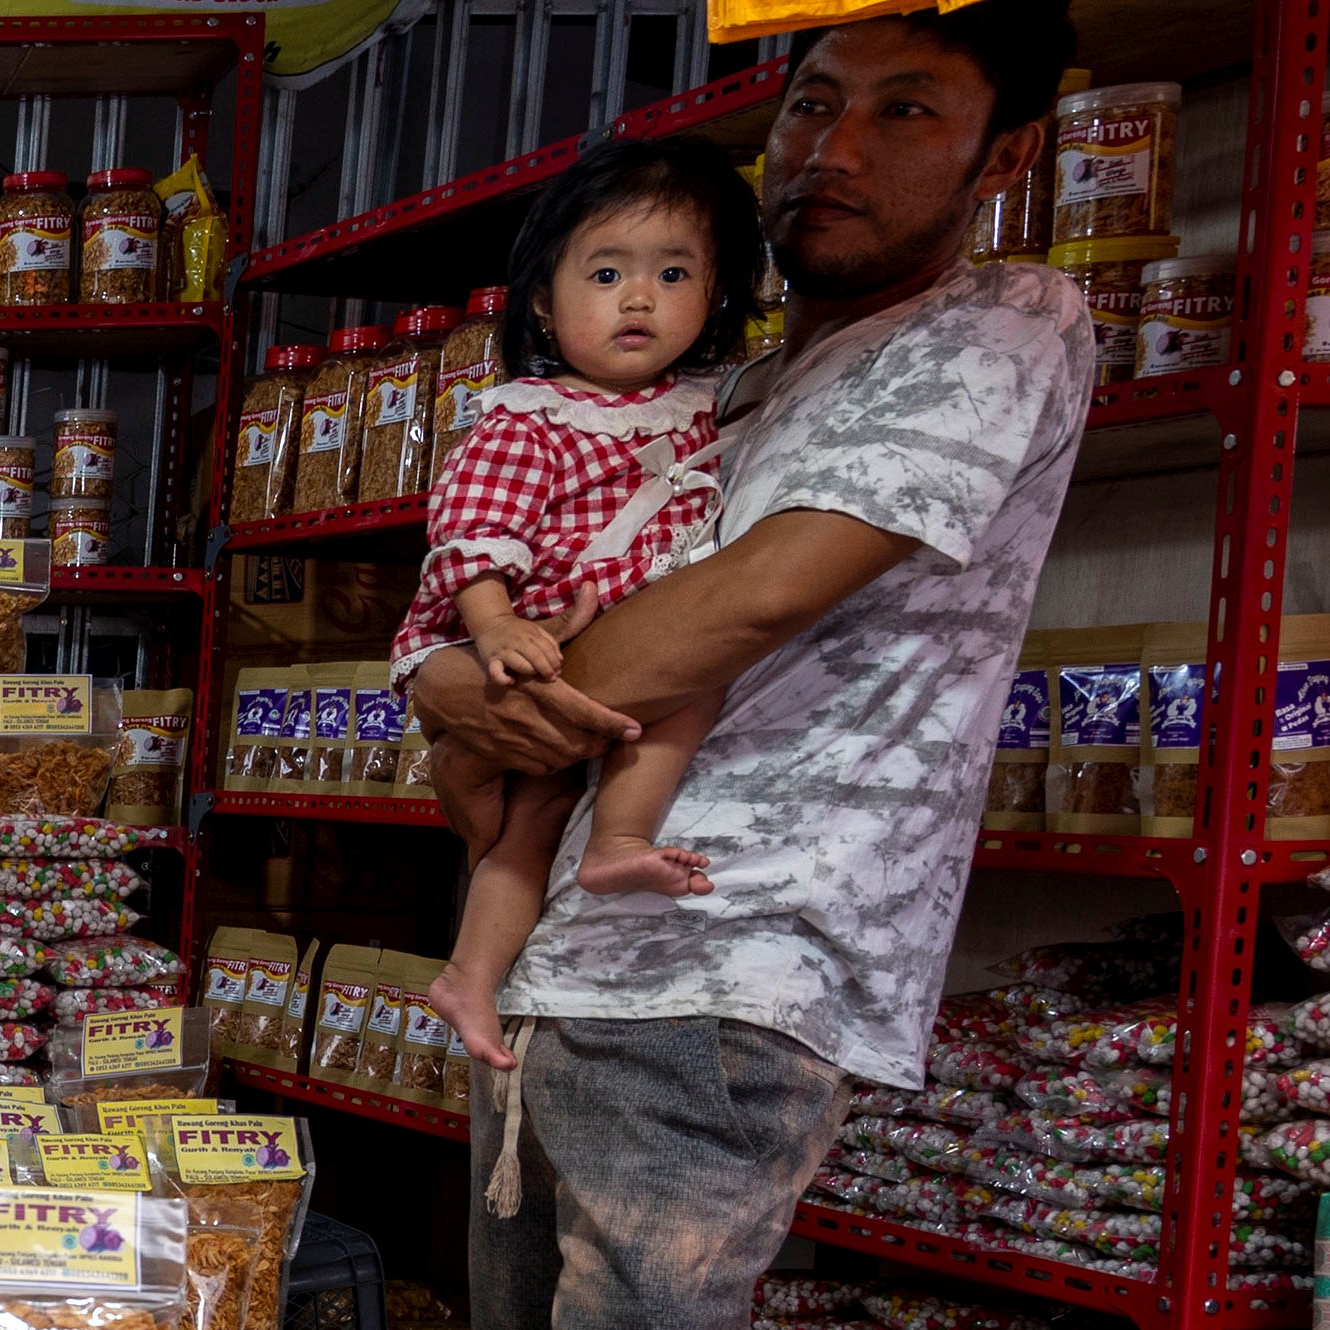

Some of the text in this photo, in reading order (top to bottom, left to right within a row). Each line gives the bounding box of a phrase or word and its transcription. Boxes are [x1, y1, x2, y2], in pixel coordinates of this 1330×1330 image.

[1087, 119, 1149, 143] FITRY
[36, 216, 71, 229] FITRY
[394, 360, 417, 377] FITRY
[3, 687, 79, 698] FITRY
[152, 716, 189, 730] FITRY
[341, 984, 369, 998] FITRY
[89, 1018, 170, 1038] FITRY
[178, 1130, 283, 1145] FITRY
[43, 1144, 130, 1155] FITRY
